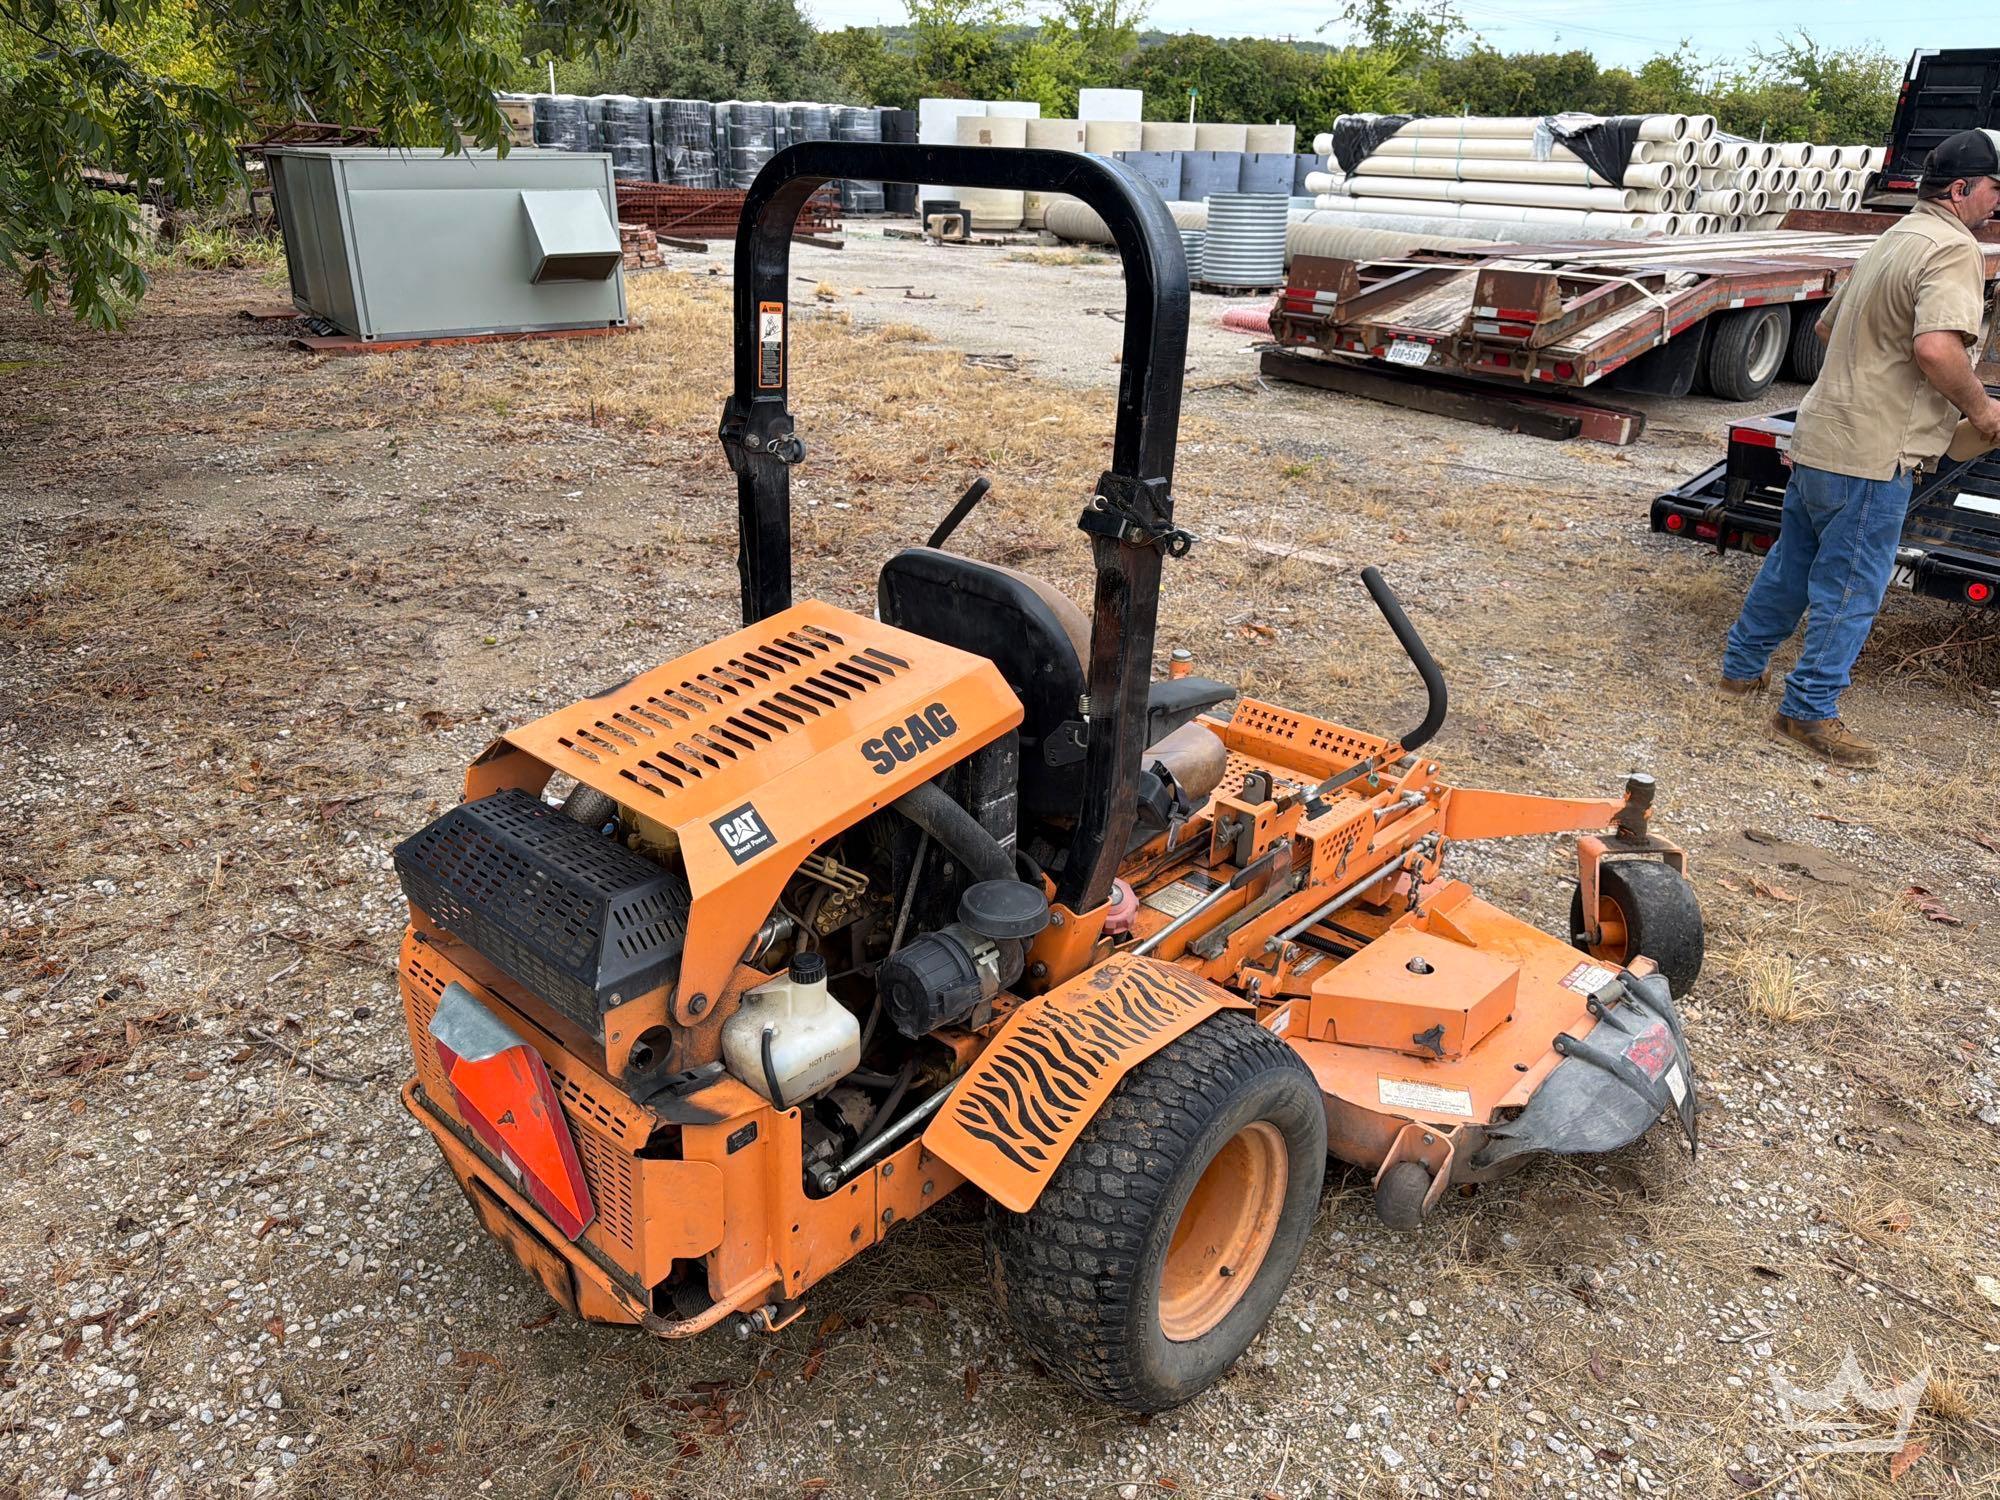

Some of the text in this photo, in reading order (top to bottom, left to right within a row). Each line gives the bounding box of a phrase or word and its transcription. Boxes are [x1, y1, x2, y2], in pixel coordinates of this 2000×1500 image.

[860, 702, 958, 775] SCAG
[719, 810, 761, 847] CAT
[734, 834, 768, 857] Diesel Power
